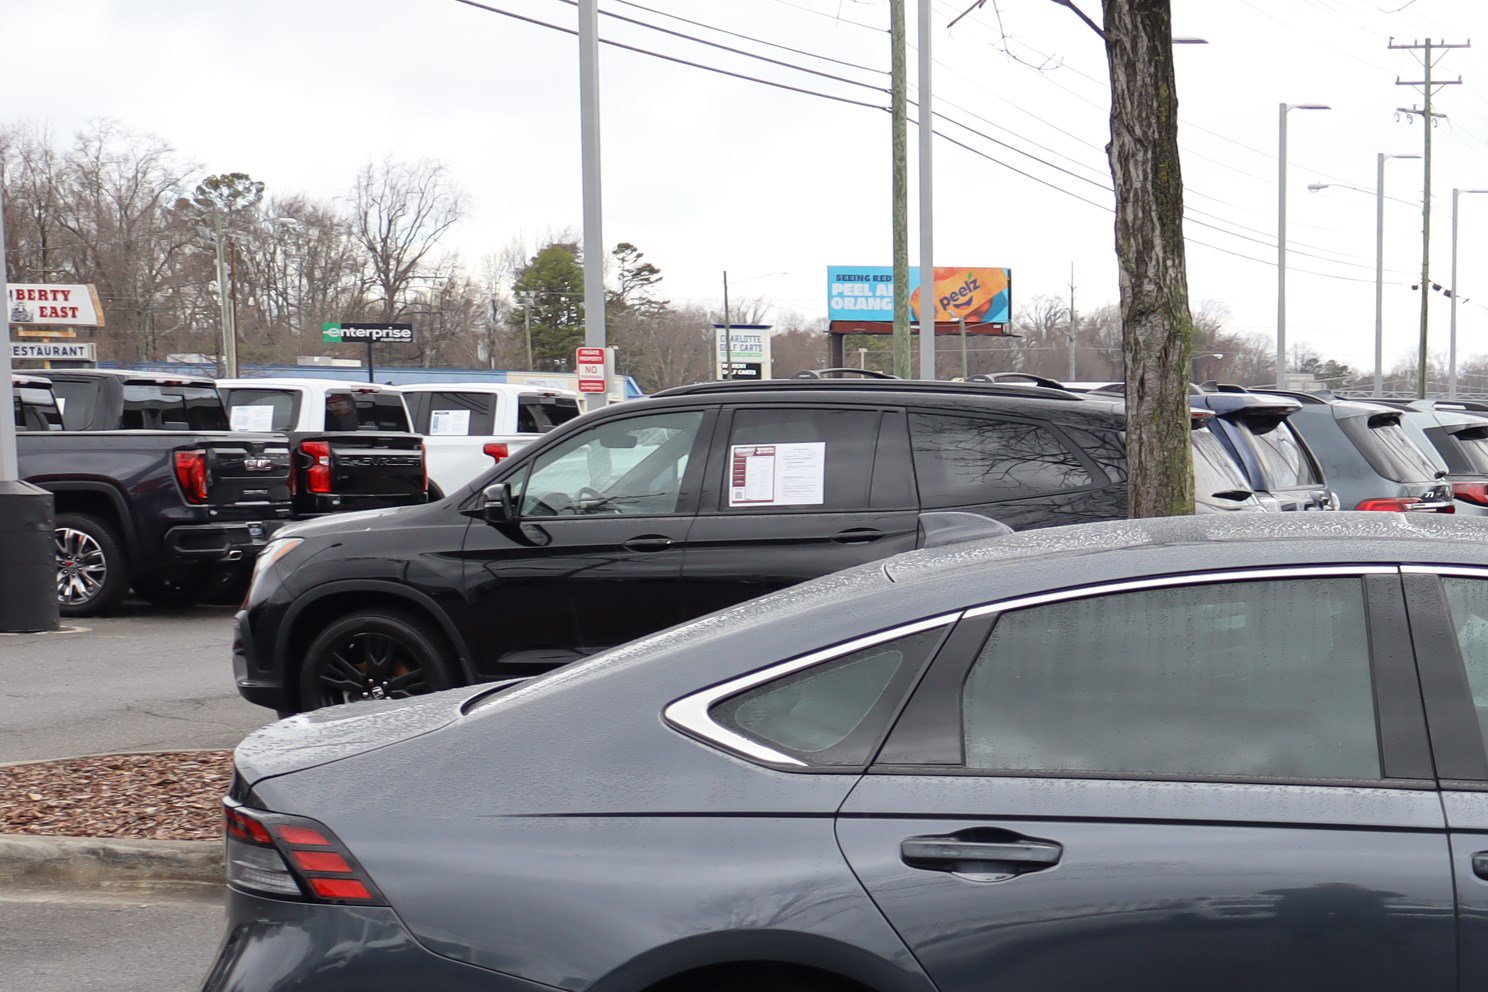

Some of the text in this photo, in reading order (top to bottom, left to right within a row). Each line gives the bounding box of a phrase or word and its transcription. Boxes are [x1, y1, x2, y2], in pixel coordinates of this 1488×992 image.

[836, 274, 871, 282] SEEING
[831, 283, 873, 296] PEEL
[939, 278, 981, 311] peelz
[831, 297, 893, 310] ORANG
[39, 306, 79, 319] EAST
[322, 326, 412, 341] enterprise
[720, 334, 762, 343] CARLOTTE
[12, 346, 85, 356] ESTAURANT
[585, 365, 598, 374] NO
